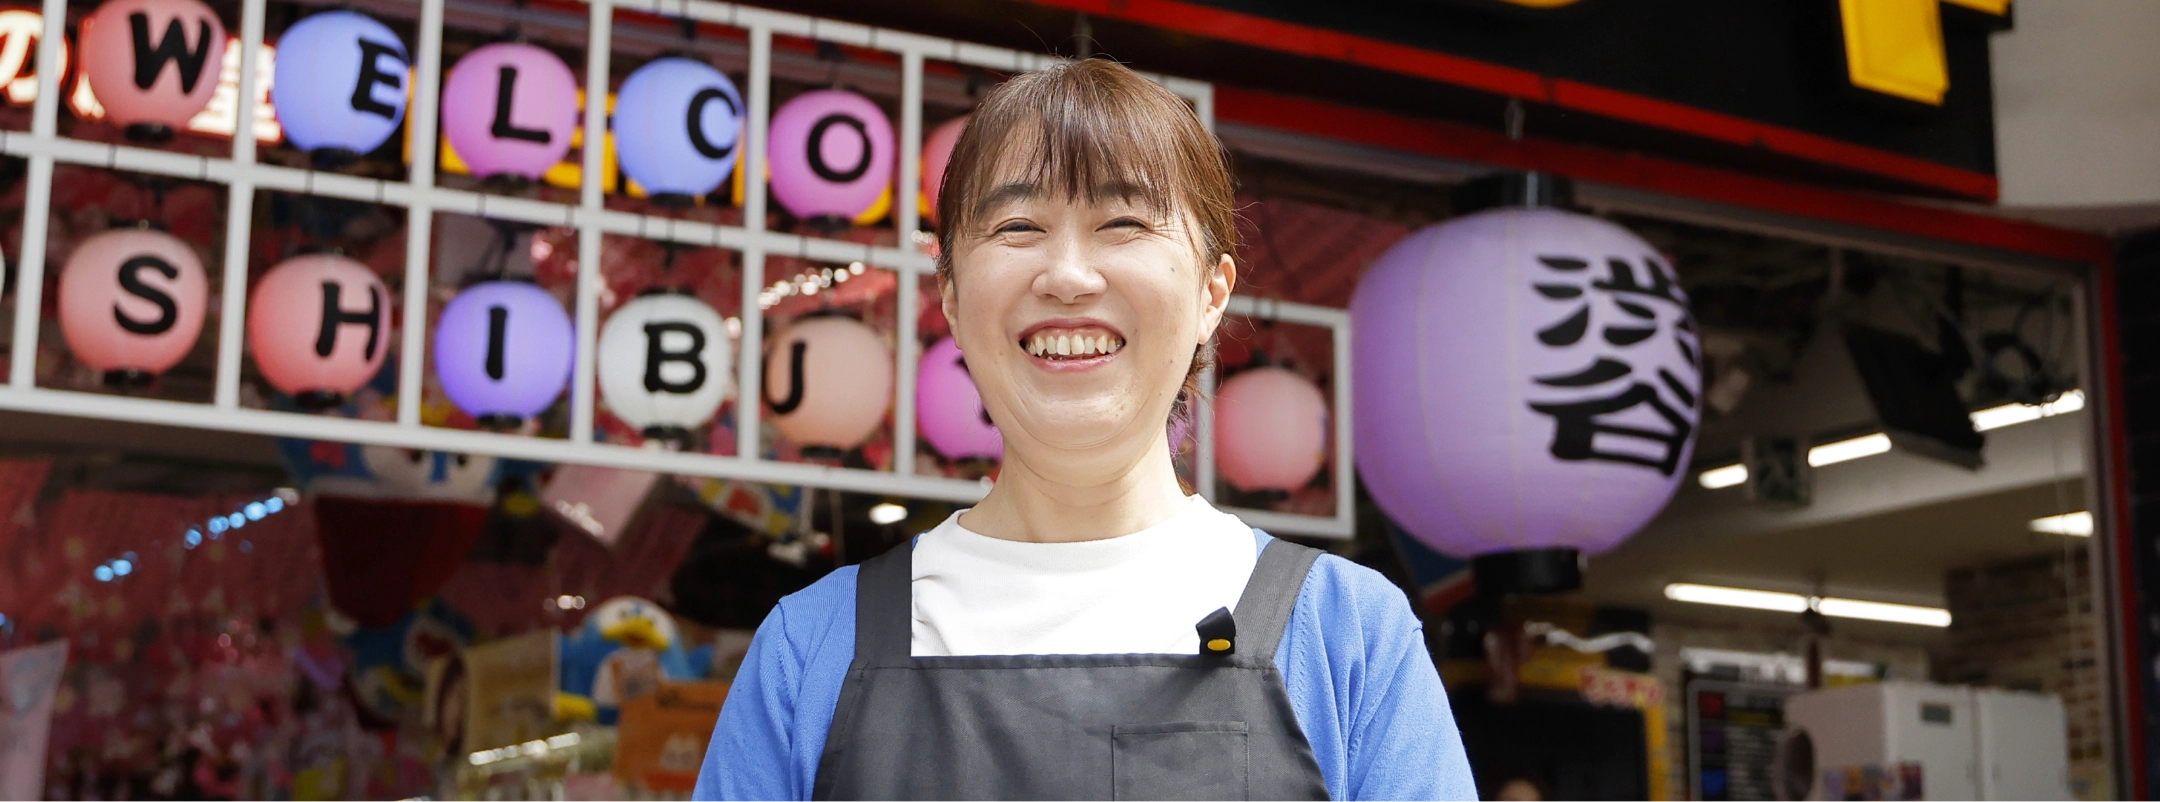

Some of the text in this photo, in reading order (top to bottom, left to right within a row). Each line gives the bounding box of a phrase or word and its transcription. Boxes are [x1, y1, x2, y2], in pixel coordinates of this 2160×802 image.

[130, 11, 873, 184] WELCO
[114, 255, 994, 425] SHIBU
[1527, 254, 1699, 477] 渋谷
